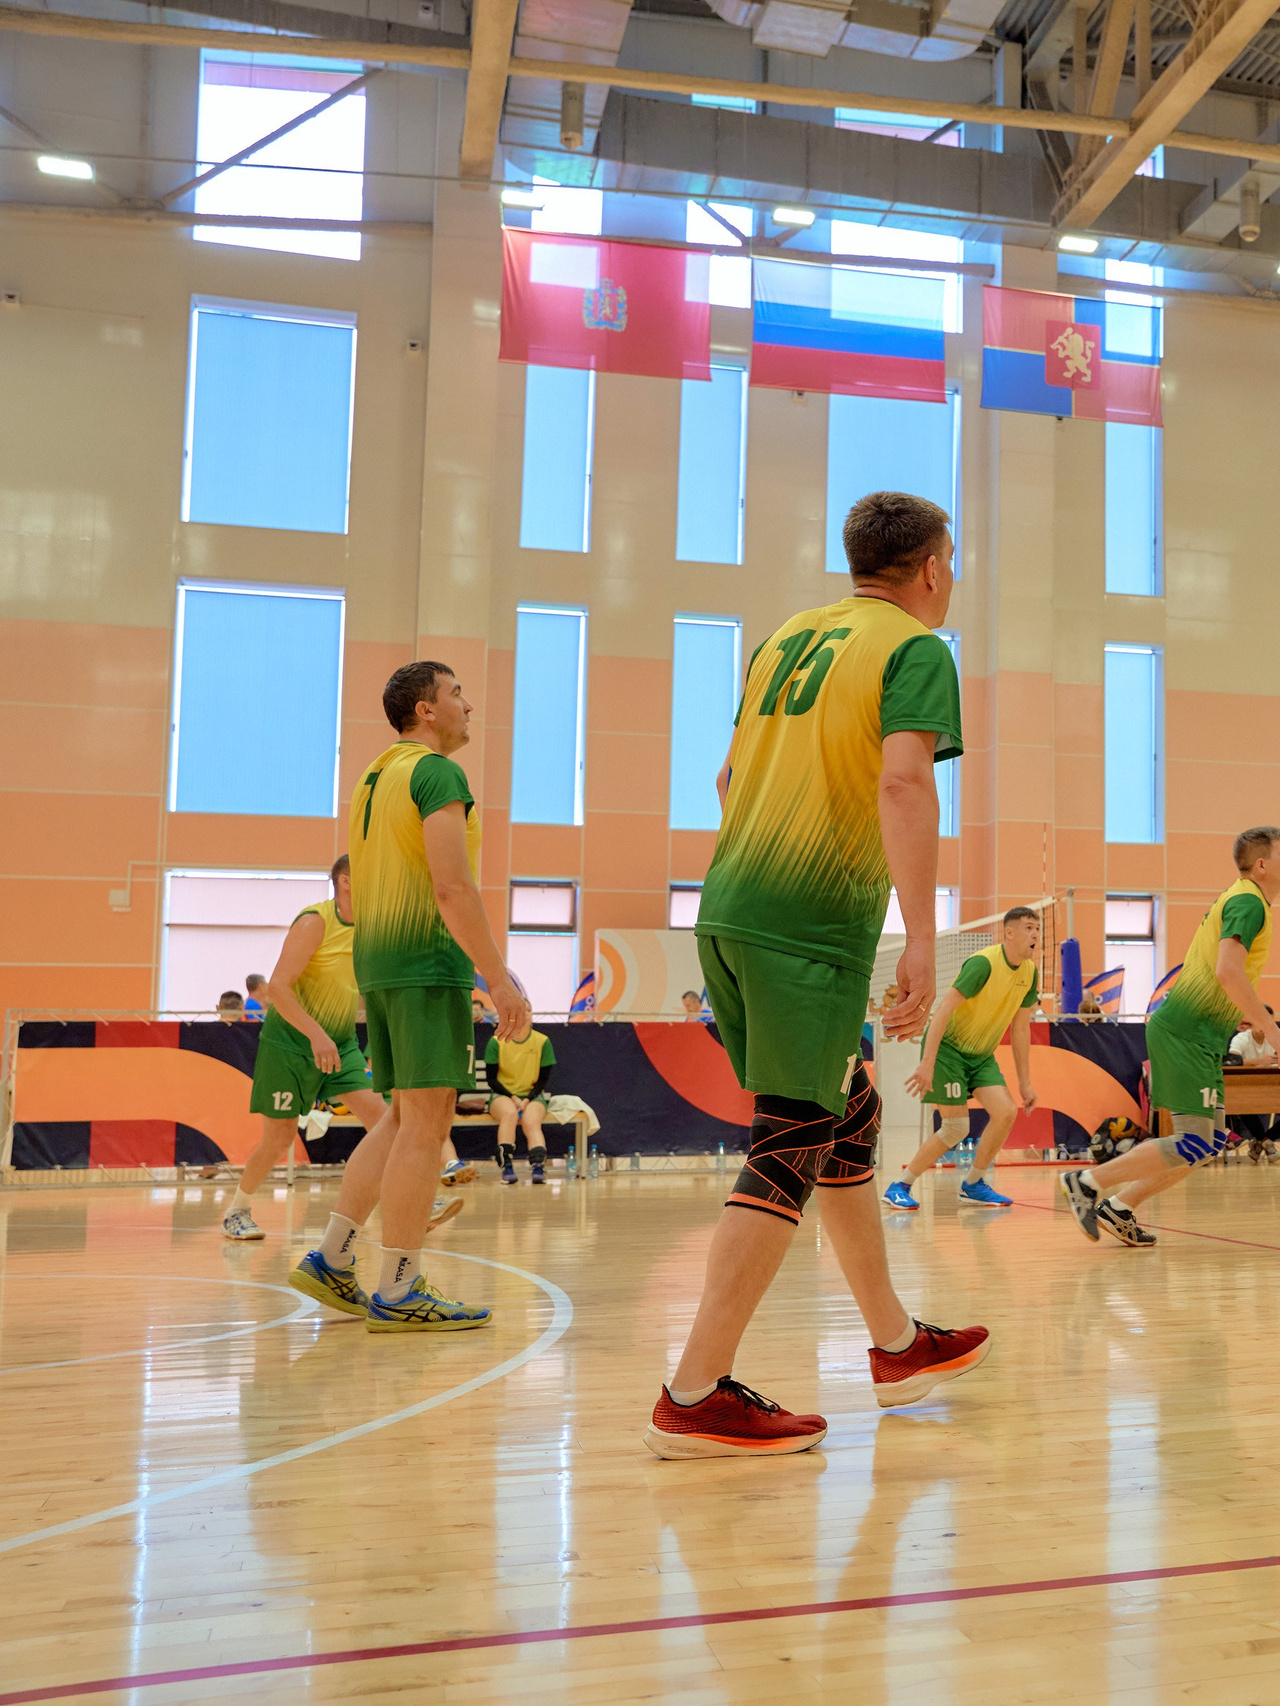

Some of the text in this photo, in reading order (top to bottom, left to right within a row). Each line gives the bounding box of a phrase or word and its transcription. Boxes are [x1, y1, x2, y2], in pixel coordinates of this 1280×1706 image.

[758, 627, 852, 716] 15
[944, 1082, 961, 1098] 10
[1200, 1087, 1218, 1109] 14
[272, 1091, 294, 1111] 12
